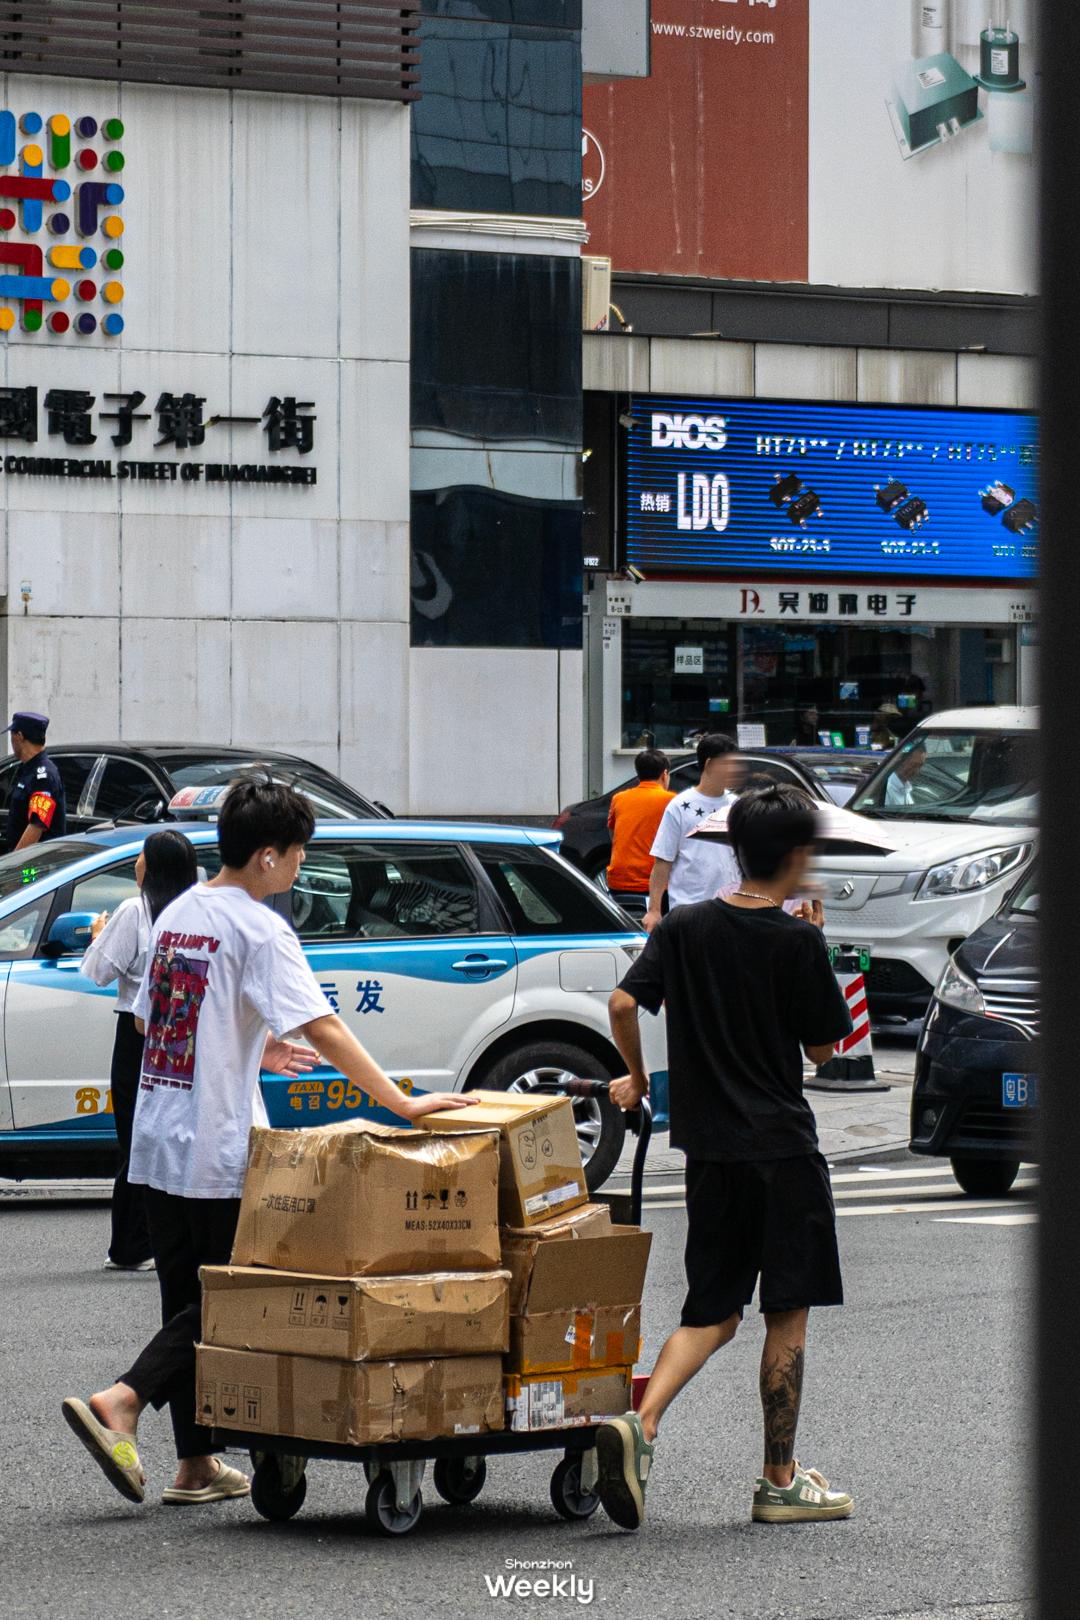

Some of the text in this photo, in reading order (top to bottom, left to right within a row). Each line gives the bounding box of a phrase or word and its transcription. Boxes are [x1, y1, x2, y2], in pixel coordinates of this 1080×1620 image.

[652, 22, 775, 45] www.szweidy.com
[651, 413, 728, 450] DIOS
[117, 461, 180, 481] STREET
[180, 462, 204, 481] OF
[640, 492, 672, 513] 热销
[676, 472, 730, 532] LDO
[293, 1083, 322, 1092] TAXI
